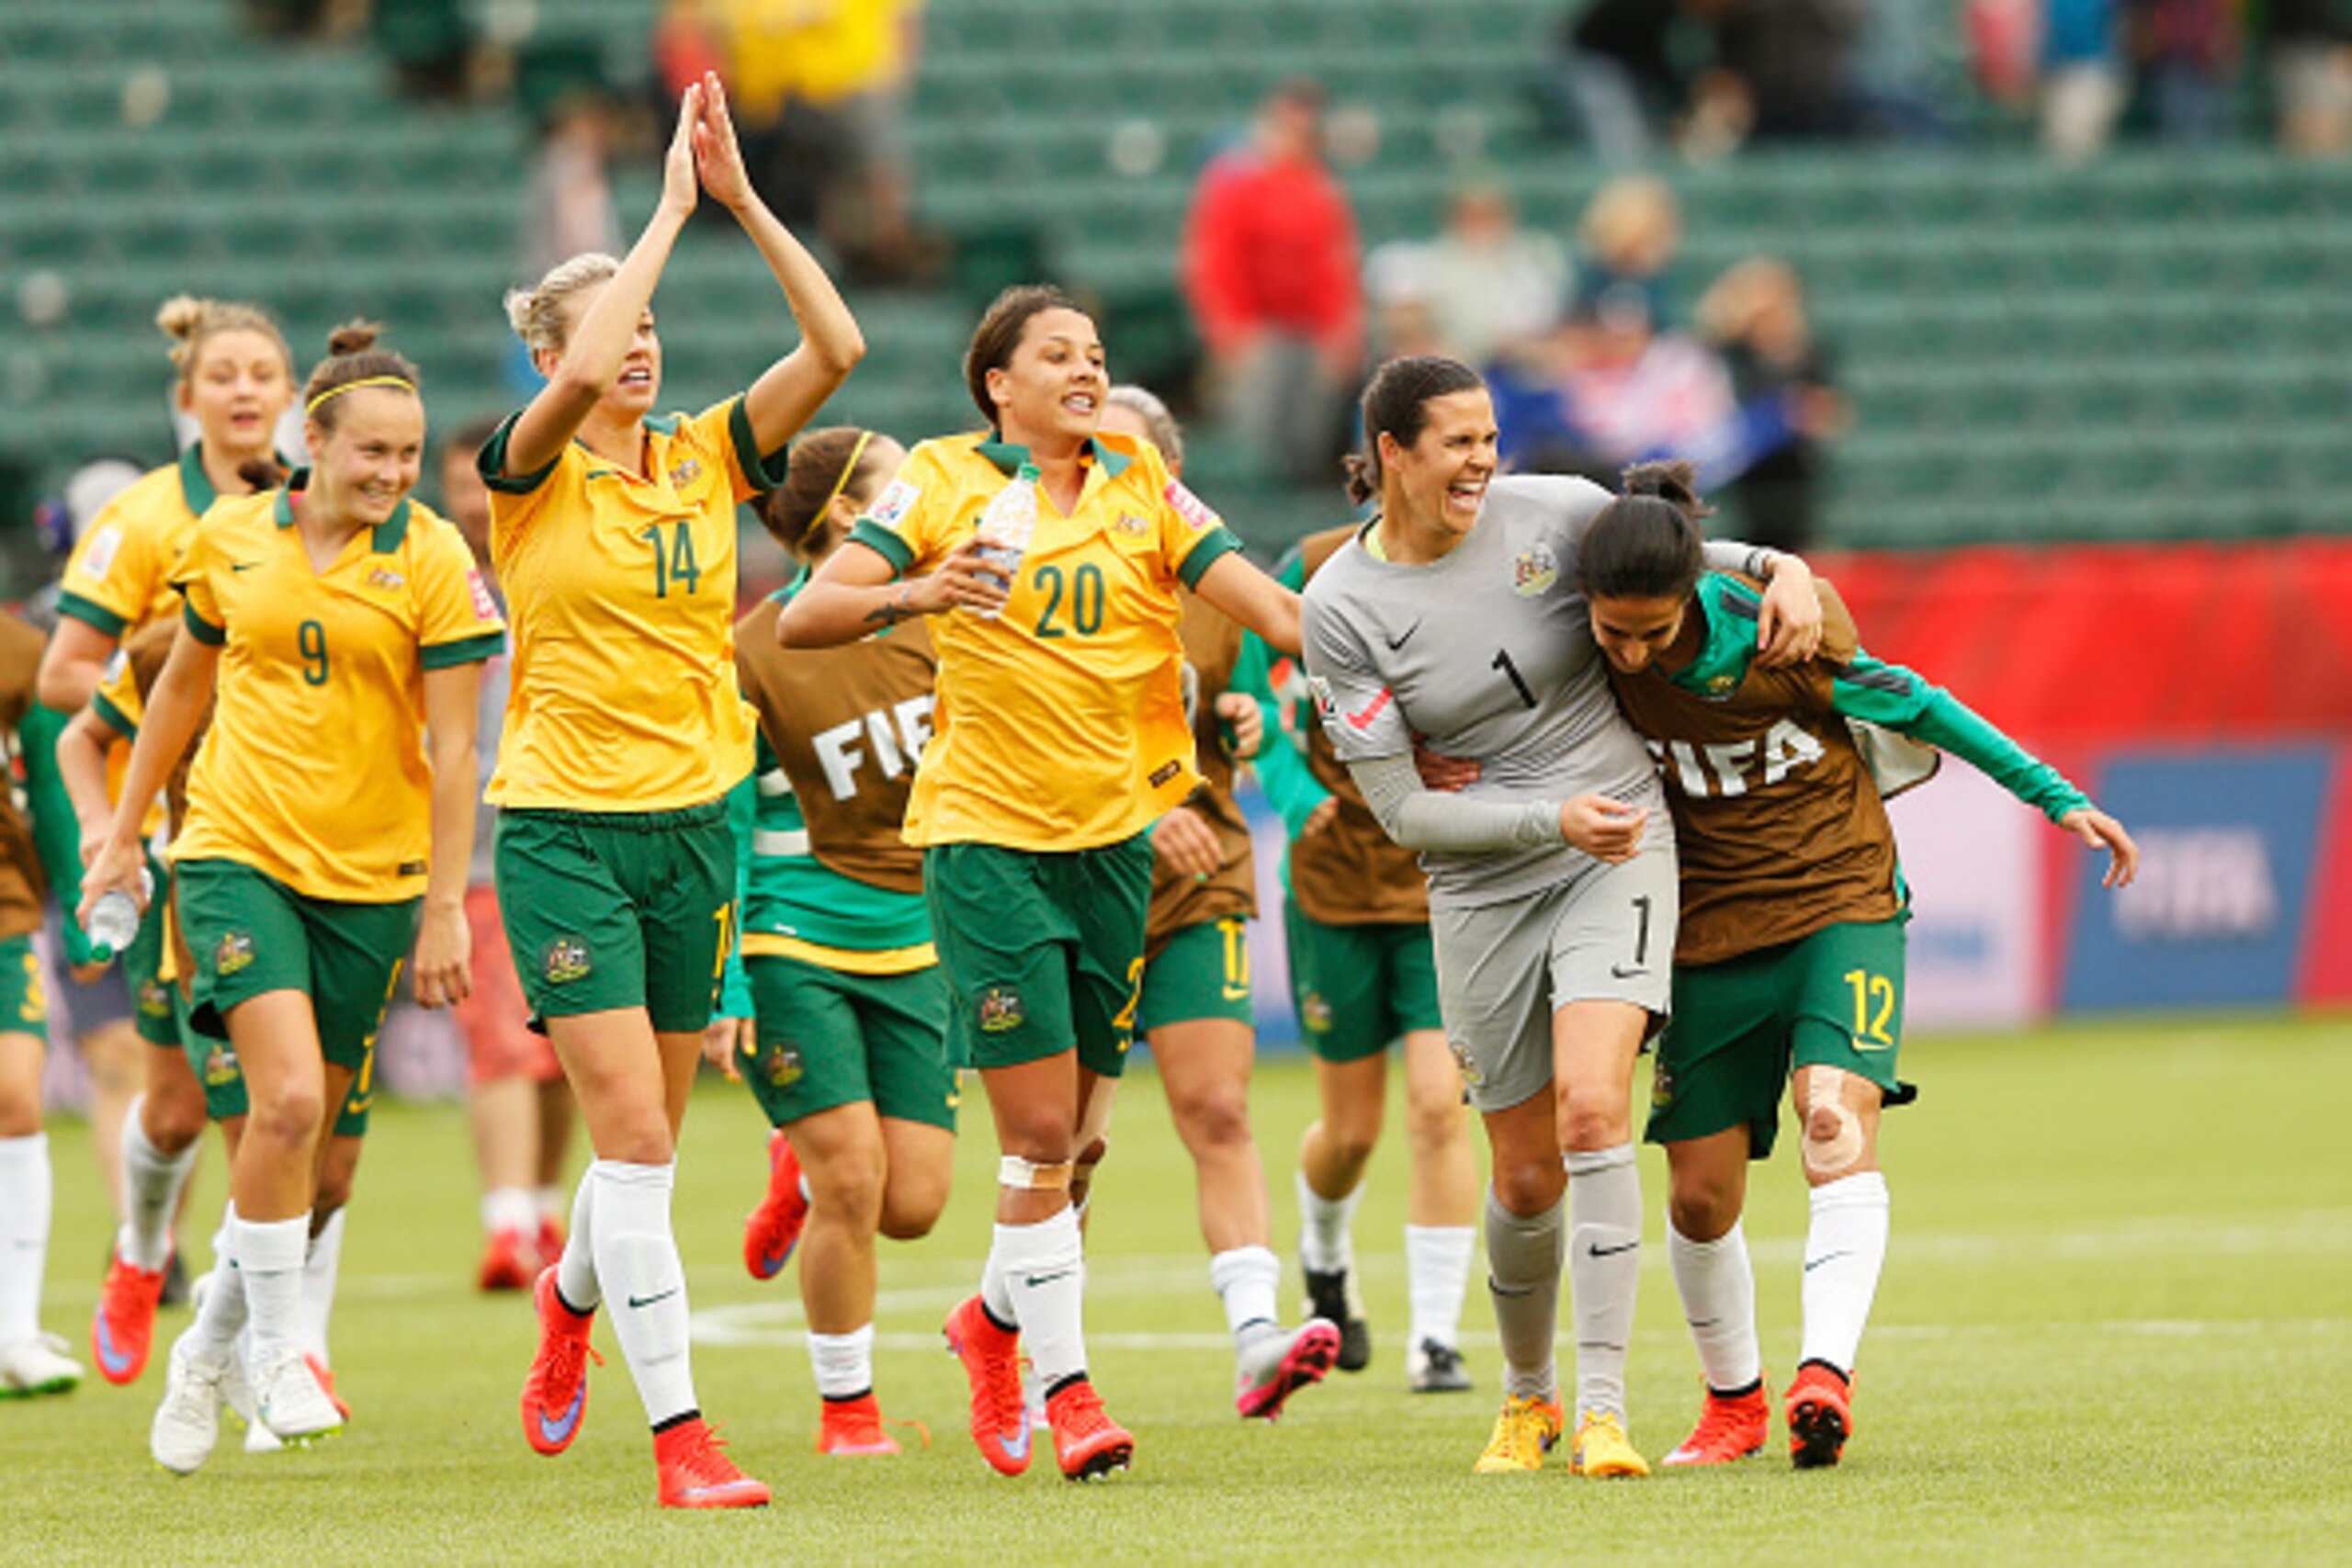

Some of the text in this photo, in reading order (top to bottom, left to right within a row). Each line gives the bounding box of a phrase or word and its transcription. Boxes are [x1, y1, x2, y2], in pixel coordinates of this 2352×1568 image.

[643, 521, 701, 599] 14
[1034, 562, 1105, 639] 20
[298, 619, 329, 686] 9
[1491, 648, 1537, 709] 1
[1630, 895, 1653, 965] 1
[1844, 969, 1894, 1047] 12
